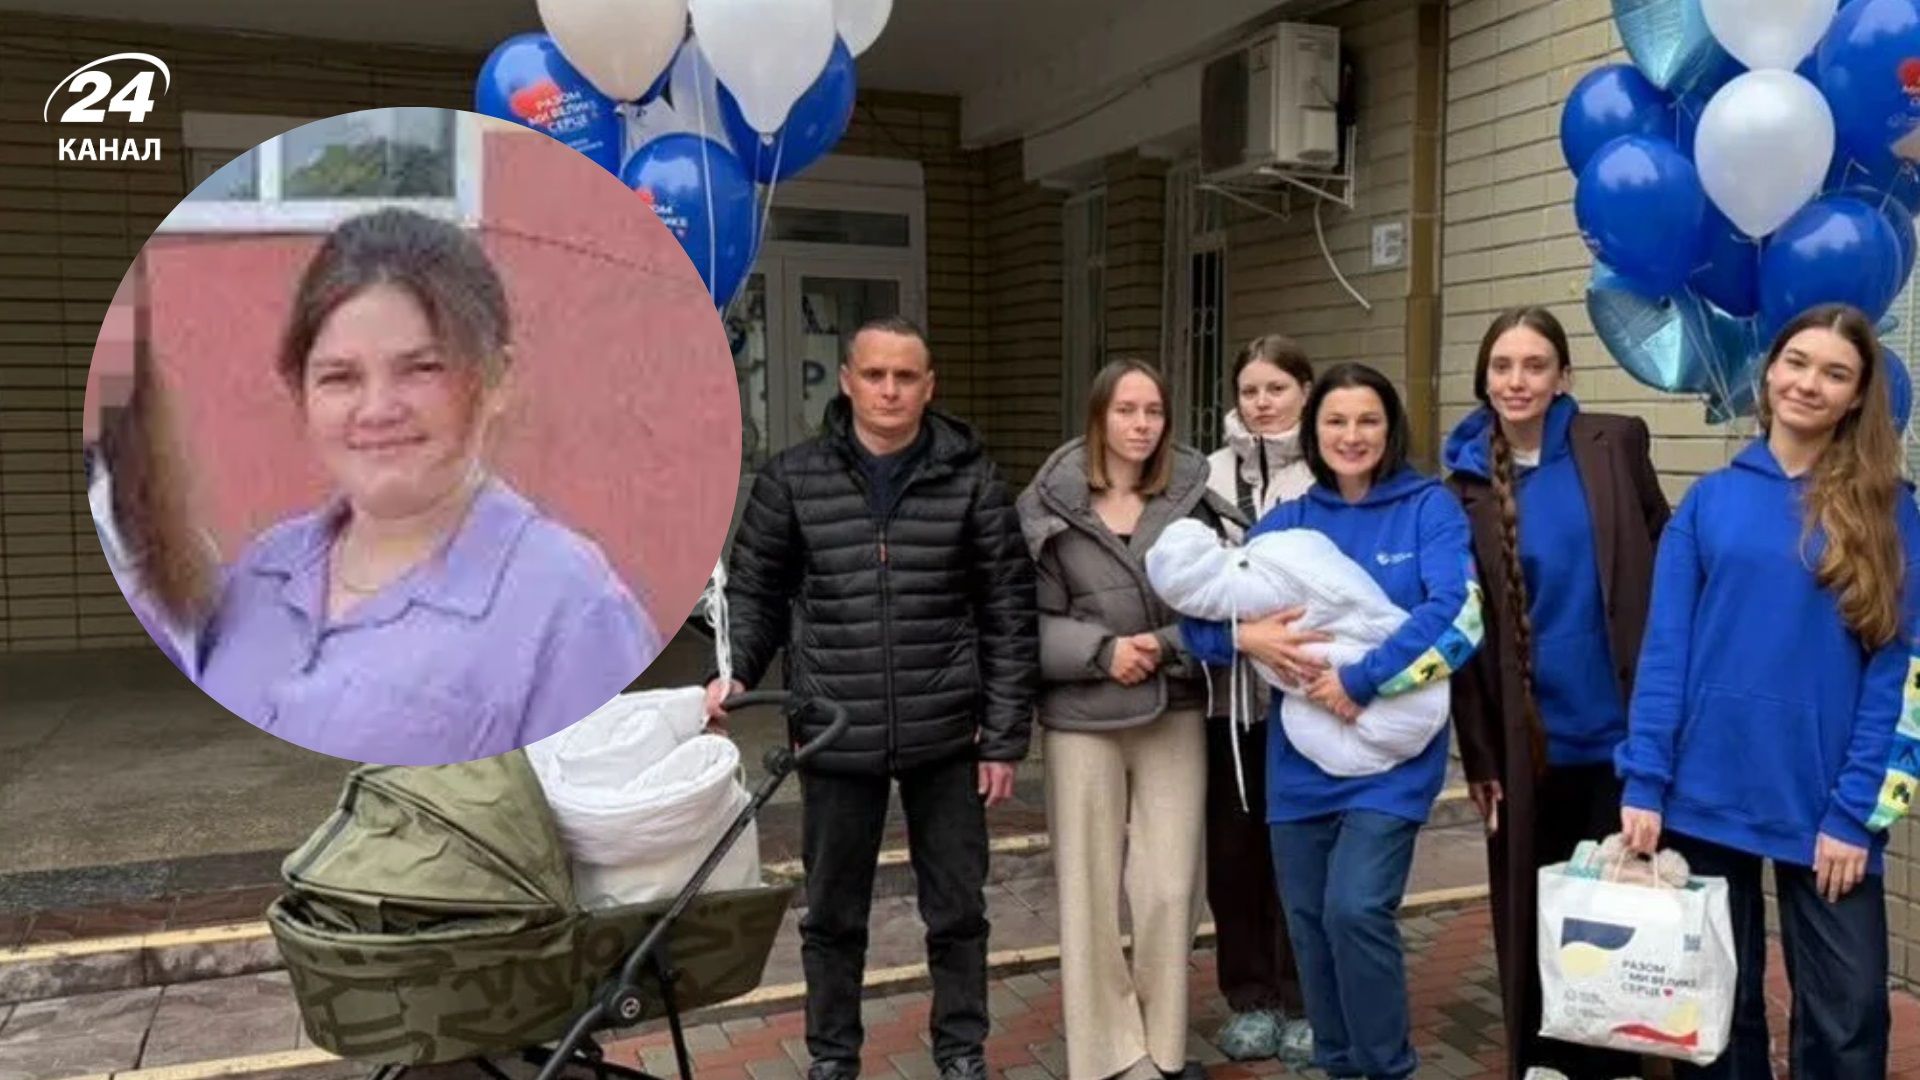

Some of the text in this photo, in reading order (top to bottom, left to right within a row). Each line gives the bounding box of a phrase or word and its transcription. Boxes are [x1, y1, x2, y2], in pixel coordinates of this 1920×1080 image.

[1621, 960, 1666, 973] РАЗОМ
[1651, 975, 1697, 988] ВЕЛИКЕ
[1620, 982, 1660, 997] СЕРЦЕ
